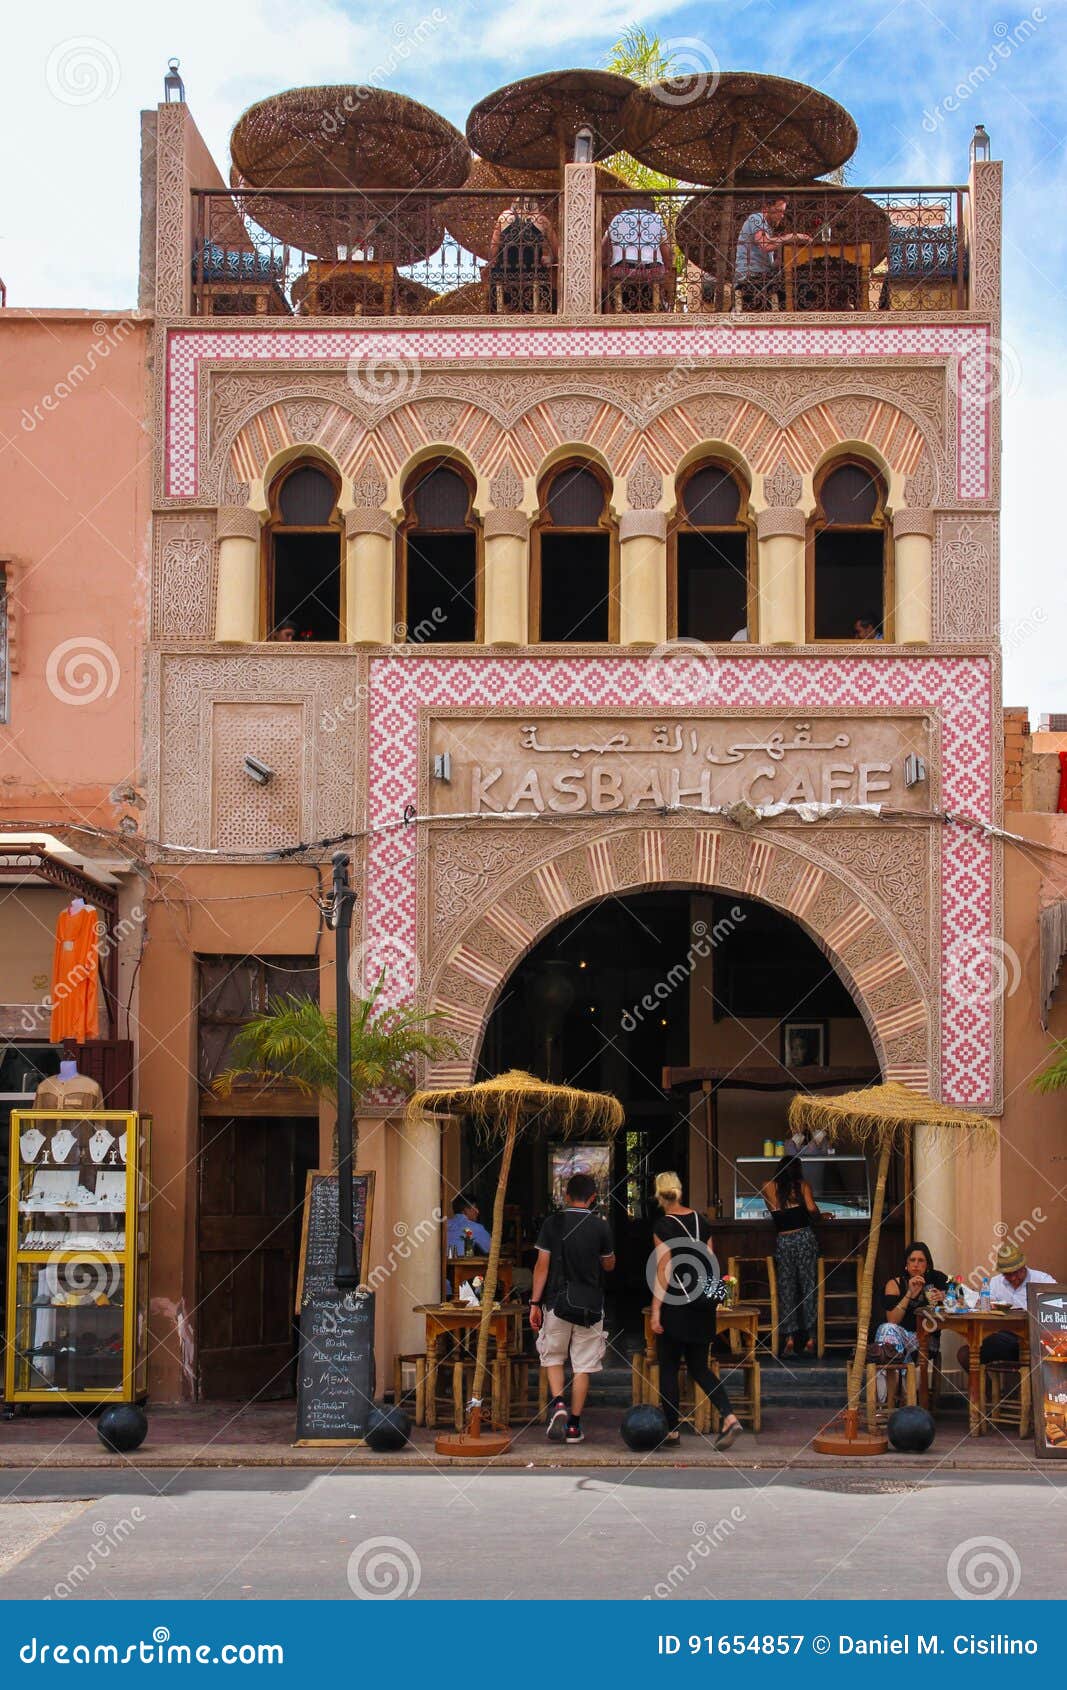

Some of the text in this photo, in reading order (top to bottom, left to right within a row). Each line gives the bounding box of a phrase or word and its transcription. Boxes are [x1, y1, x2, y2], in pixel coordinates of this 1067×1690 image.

[519, 723, 851, 765] مقهى القصبة
[471, 766, 712, 813] KASBAH
[1040, 1312, 1053, 1323] Les
